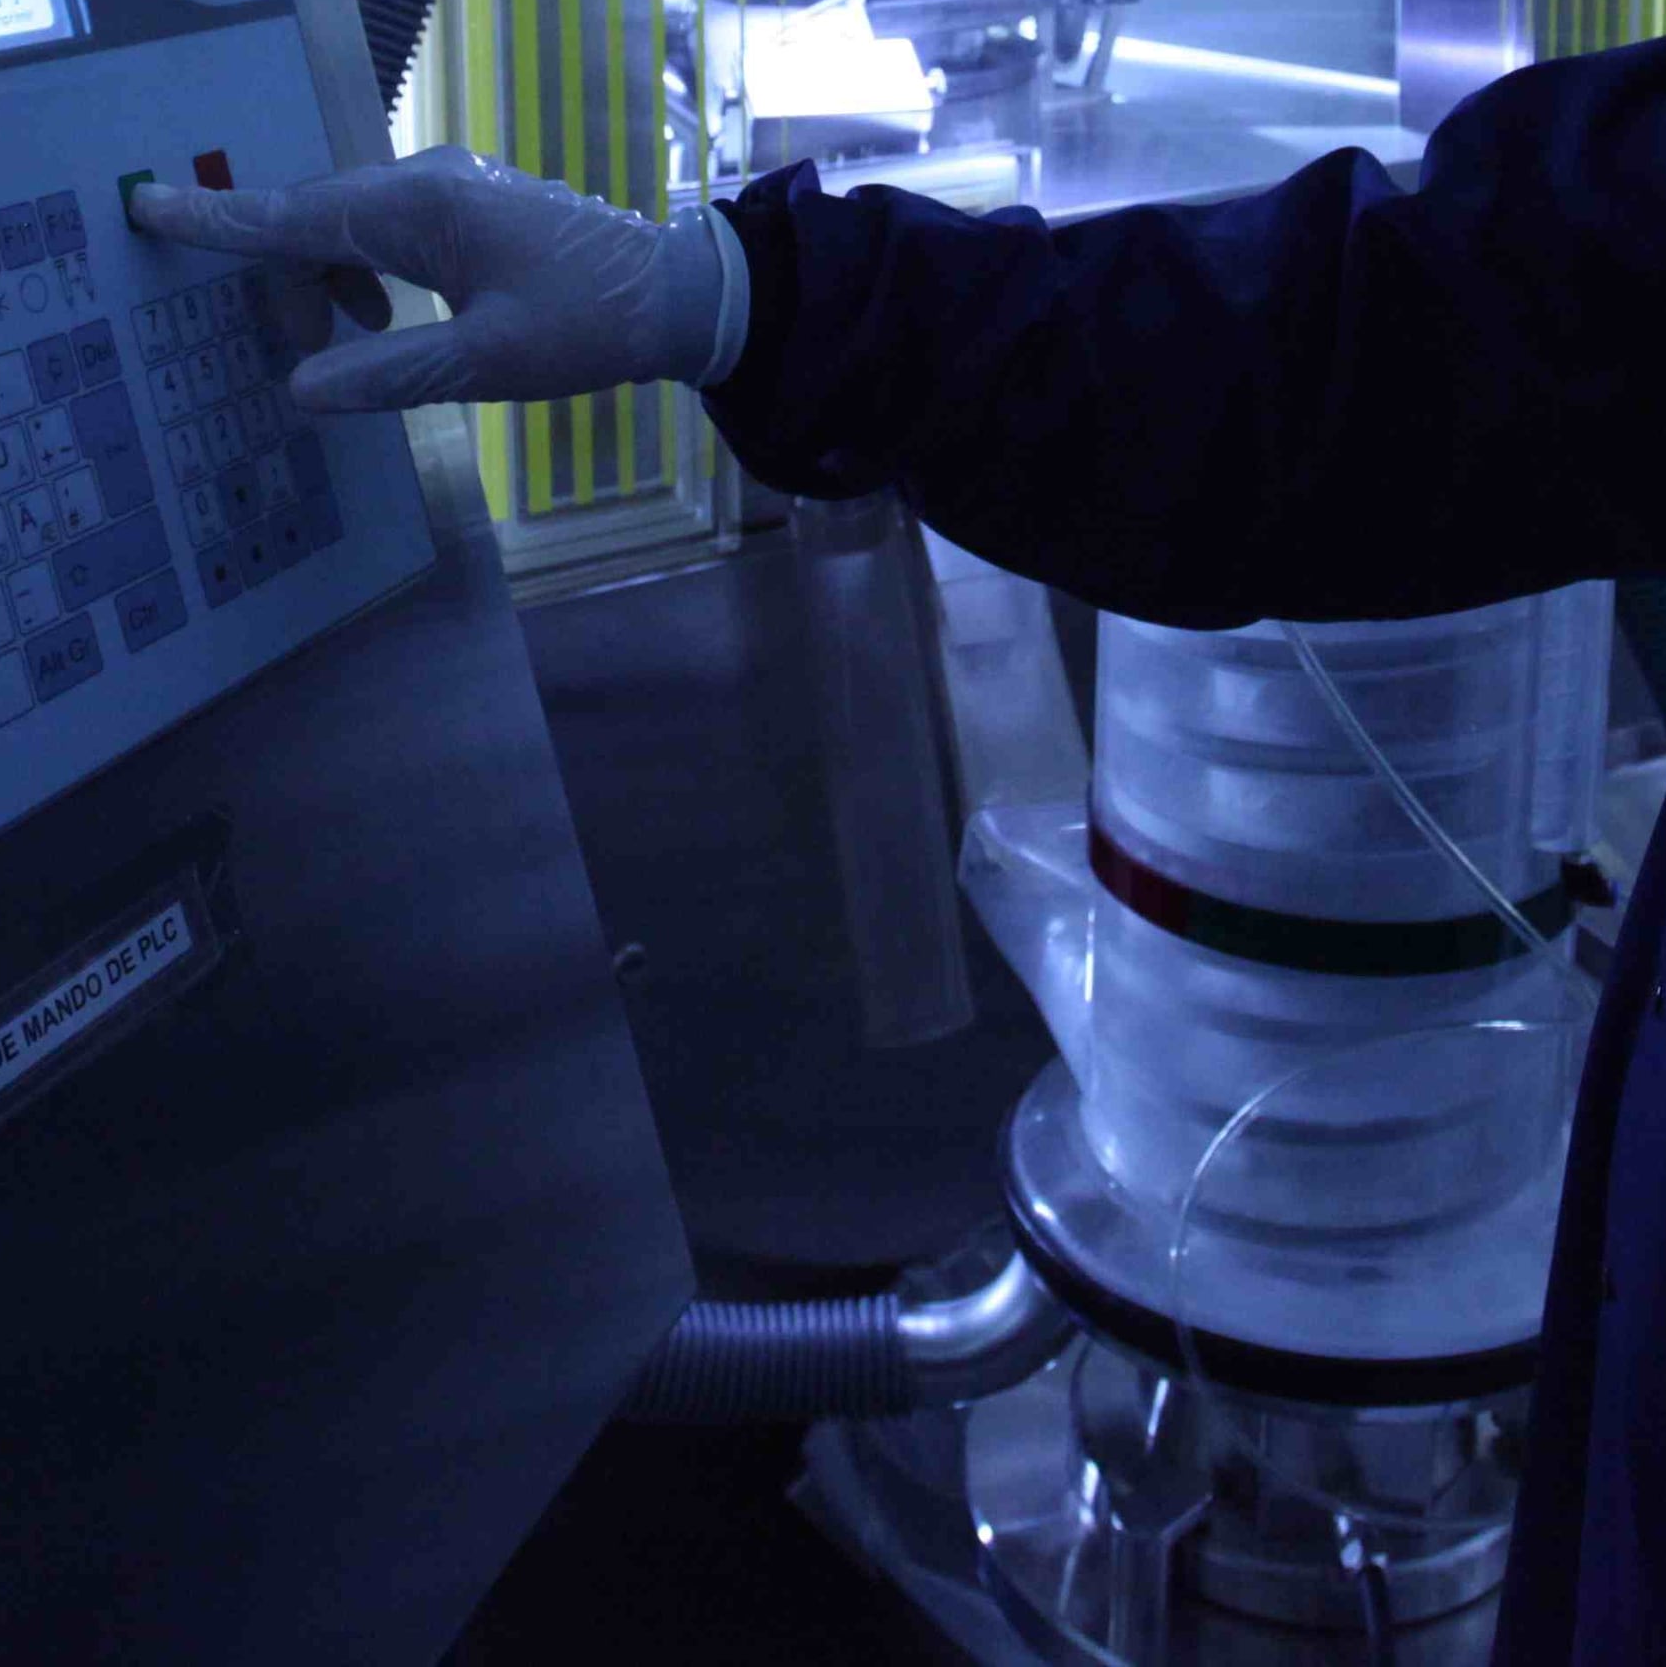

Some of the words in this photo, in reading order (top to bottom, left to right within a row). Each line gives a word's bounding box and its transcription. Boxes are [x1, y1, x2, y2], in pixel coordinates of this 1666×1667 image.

[21, 972, 103, 1048] MANDO
[105, 947, 137, 986] DE
[140, 916, 179, 963] PLC
